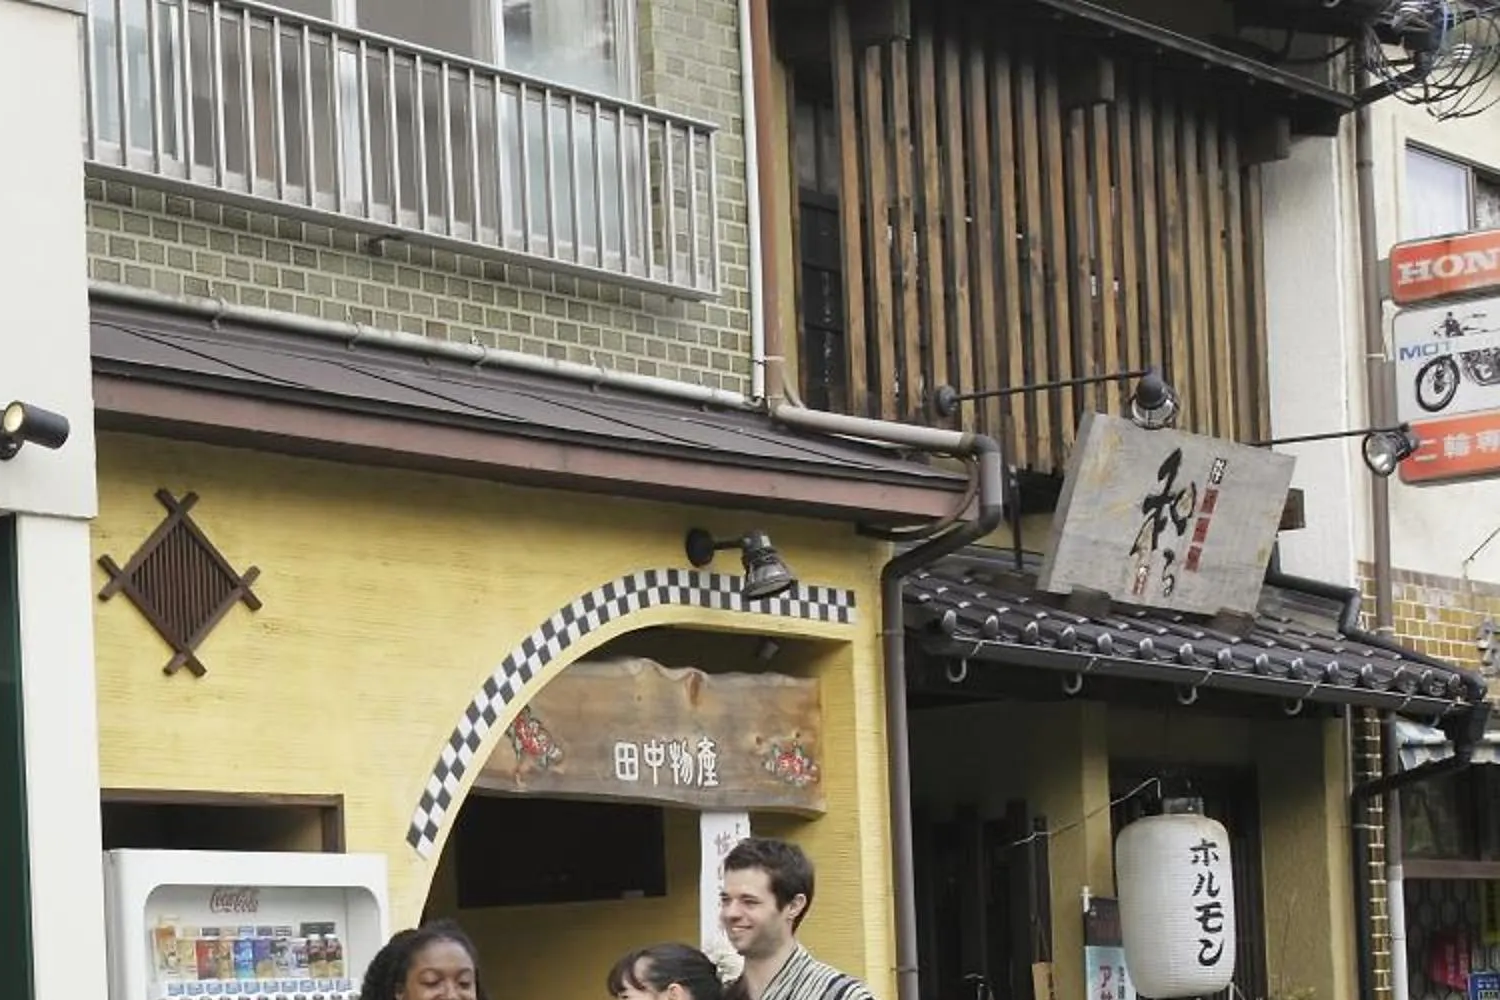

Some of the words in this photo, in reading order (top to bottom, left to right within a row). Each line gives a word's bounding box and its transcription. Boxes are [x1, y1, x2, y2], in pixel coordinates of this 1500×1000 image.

[1398, 249, 1500, 285] HON
[1189, 838, 1225, 967] ホルモン
